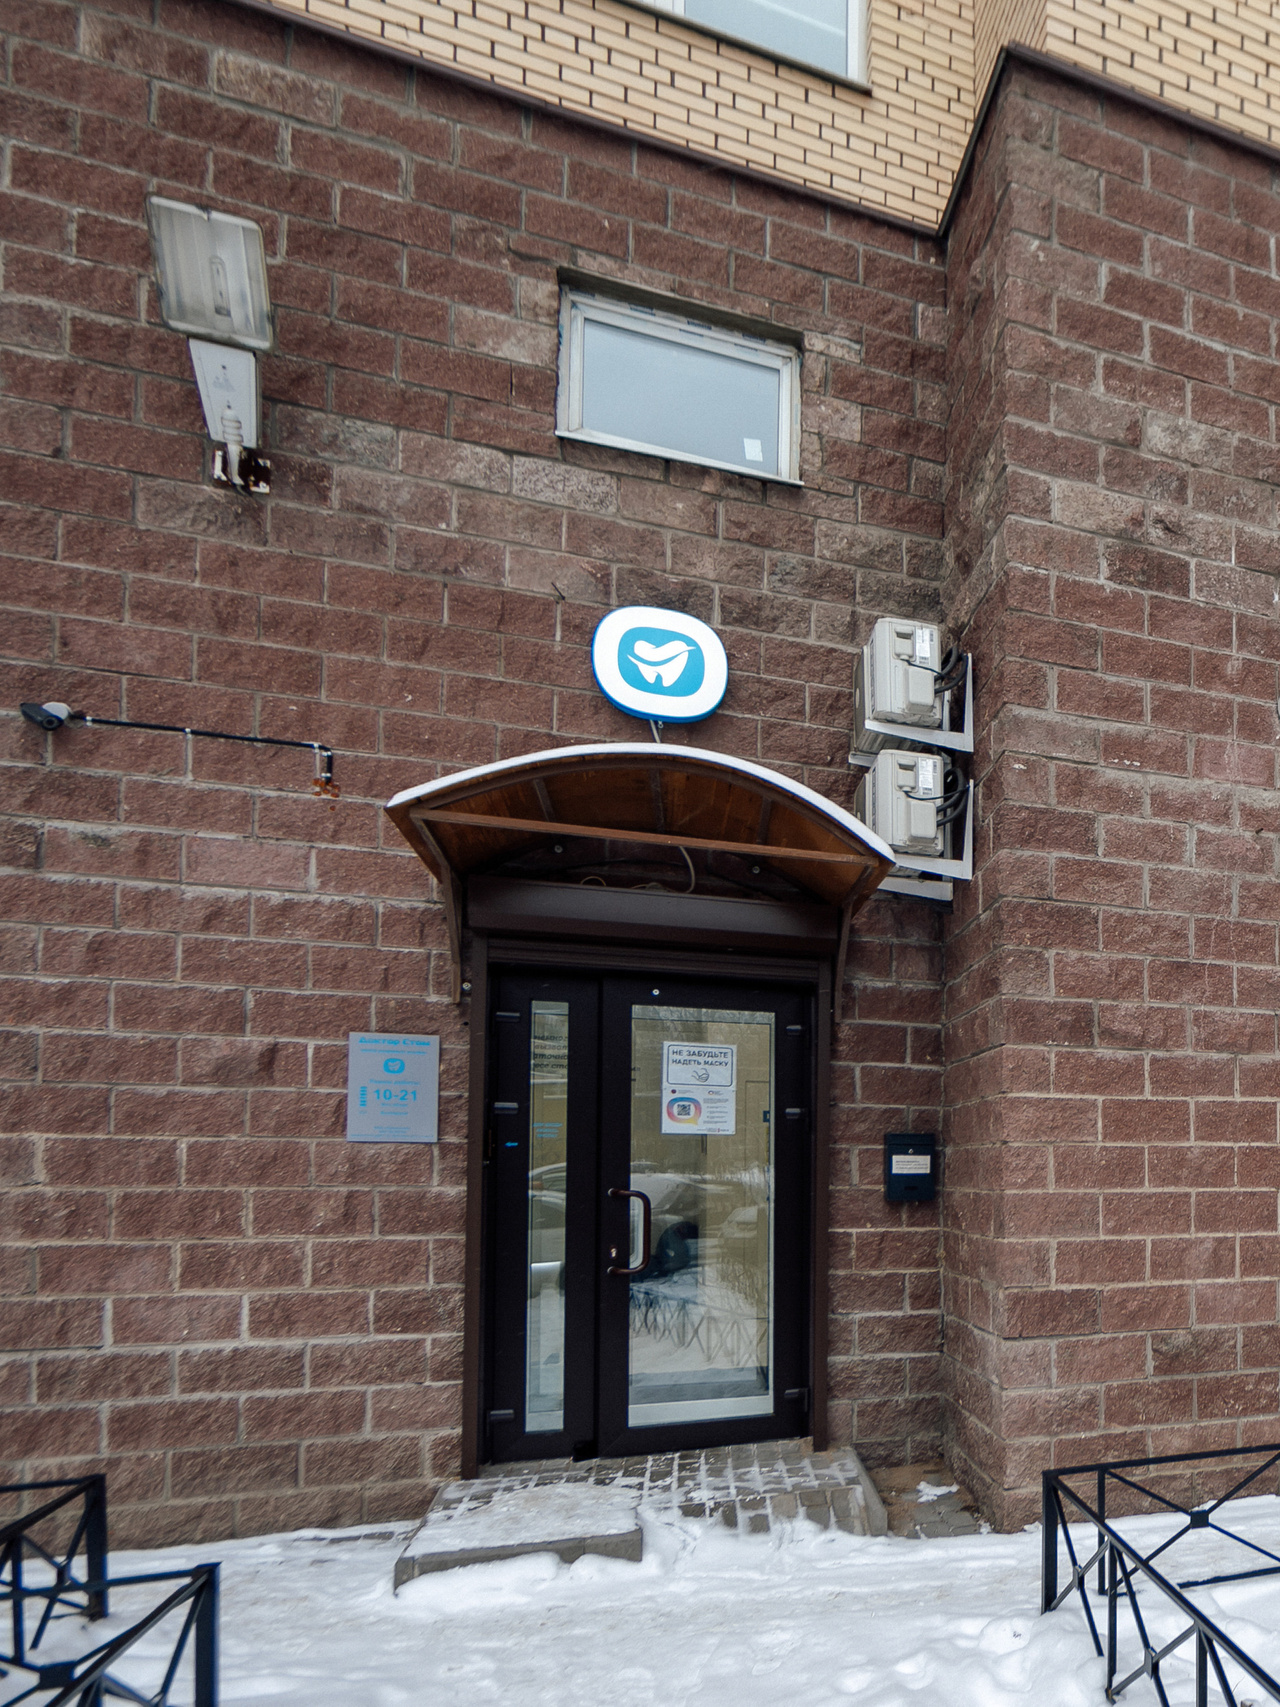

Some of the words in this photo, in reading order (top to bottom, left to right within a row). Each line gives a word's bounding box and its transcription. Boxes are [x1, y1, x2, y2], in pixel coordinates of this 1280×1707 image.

[672, 1049, 684, 1057] НЕ
[686, 1050, 729, 1059] ЗАБУДЬТЕ
[374, 1089, 417, 1101] 10-21
